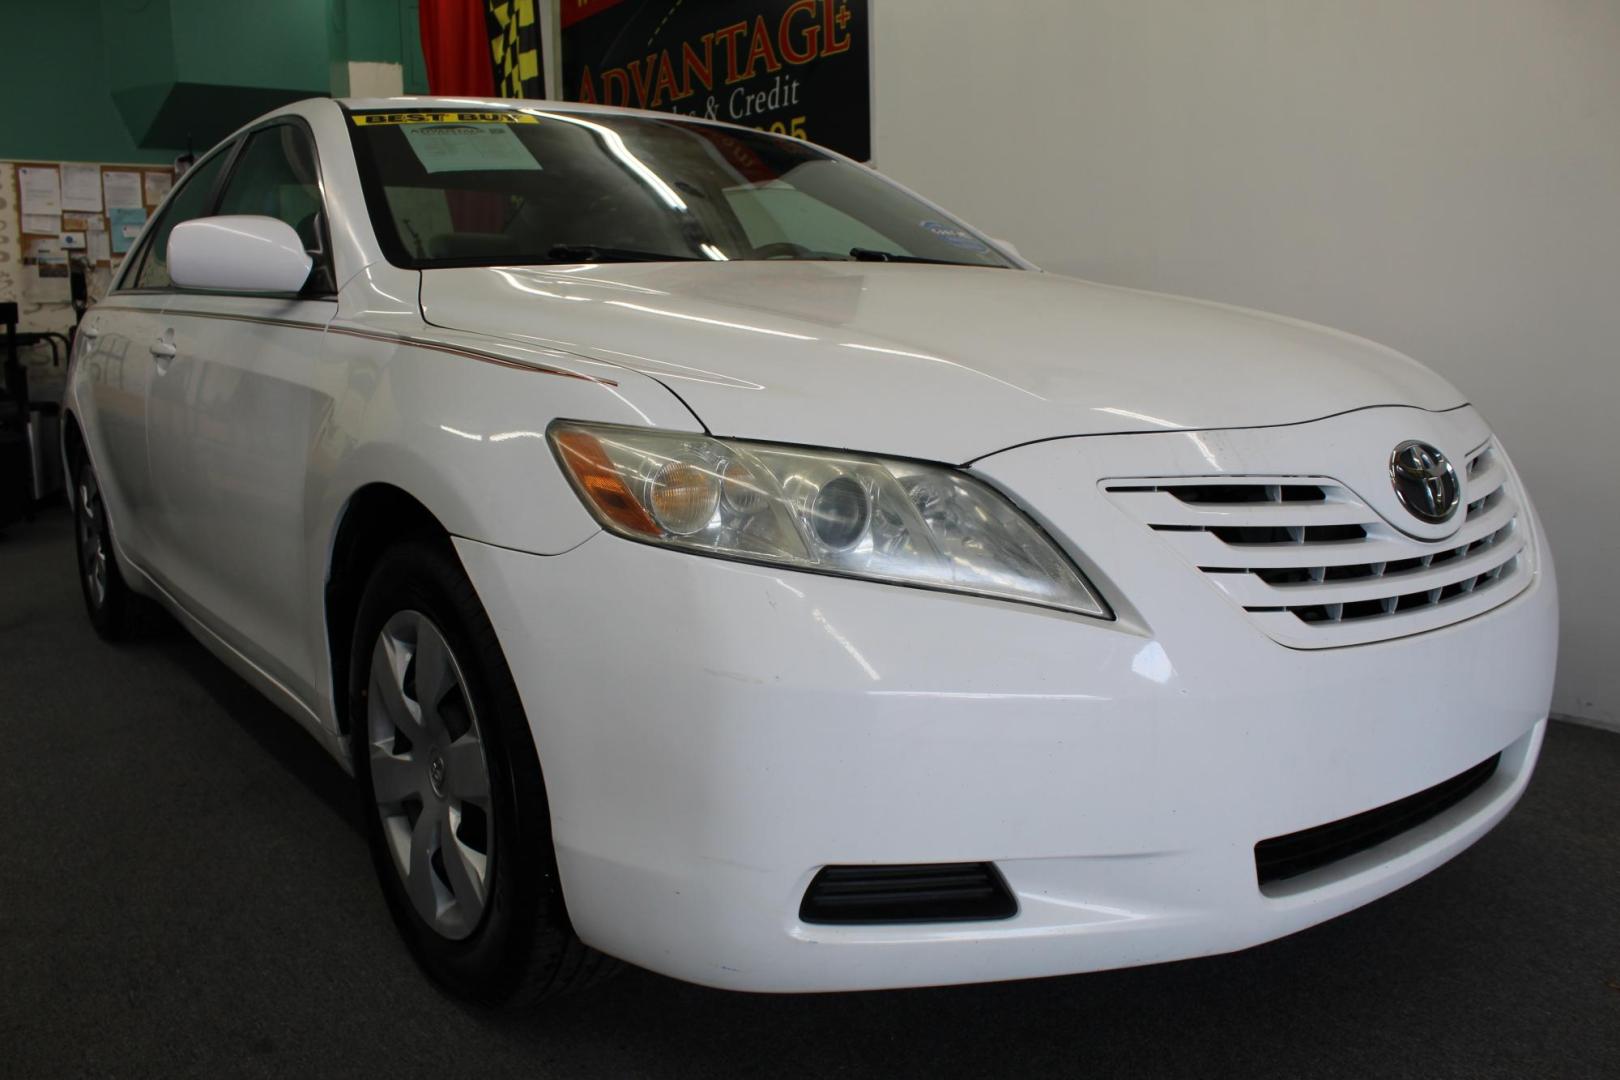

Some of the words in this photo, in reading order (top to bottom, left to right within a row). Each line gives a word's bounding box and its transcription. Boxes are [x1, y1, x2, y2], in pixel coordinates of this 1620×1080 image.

[729, 74, 800, 120] Credit
[365, 113, 444, 124] BEST
[457, 113, 521, 124] BUY
